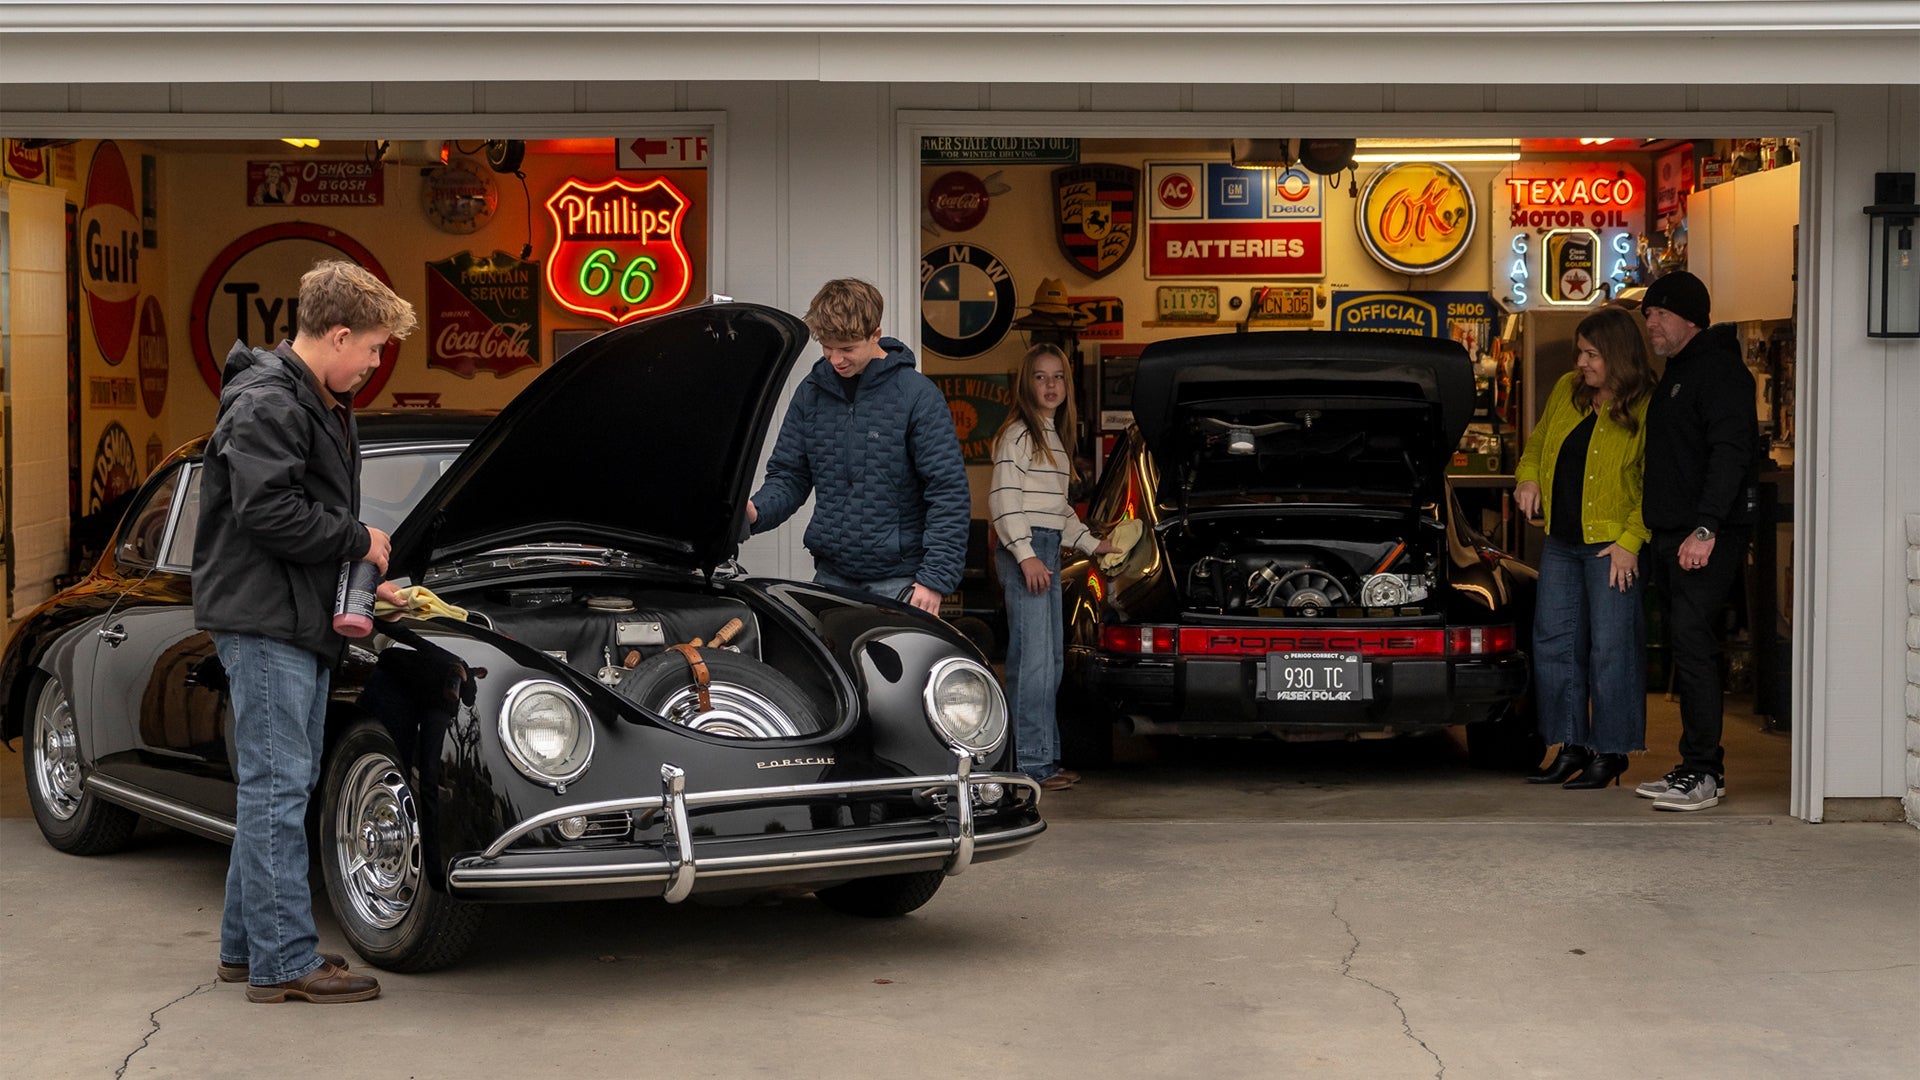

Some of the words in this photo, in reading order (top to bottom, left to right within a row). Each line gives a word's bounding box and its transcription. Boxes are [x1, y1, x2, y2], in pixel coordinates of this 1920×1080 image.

[954, 137, 989, 150] STATE
[991, 137, 1017, 150] COLD
[1020, 138, 1046, 150] TEST
[1049, 138, 1070, 150] OIL
[1163, 182, 1188, 199] AC
[1228, 183, 1243, 195] GM
[1506, 178, 1634, 205] TEXACO
[301, 193, 377, 203] OVERALLS
[1272, 204, 1315, 213] Delco
[559, 195, 671, 245] Phillips
[1511, 210, 1584, 227] MOTOR
[1591, 210, 1628, 227] OIL
[86, 219, 139, 284] Gulf
[1166, 239, 1305, 258] BATTERIES
[461, 270, 529, 284] FOUNTAIN
[580, 249, 657, 304] 66
[1510, 233, 1528, 305] GAS
[470, 286, 529, 300] SERVICE
[1191, 293, 1216, 309] 973
[1286, 297, 1309, 313] 305
[1447, 303, 1485, 316] SMOG
[1347, 304, 1426, 326] OFFICIAL
[436, 322, 532, 359] Coca-Cola
[1210, 636, 1415, 650] PORSCHE
[1284, 667, 1314, 689] 930
[1323, 667, 1343, 689] TC
[1277, 691, 1311, 700] VASEK
[1312, 691, 1352, 700] POLAK
[756, 757, 836, 769] PORSCHE
